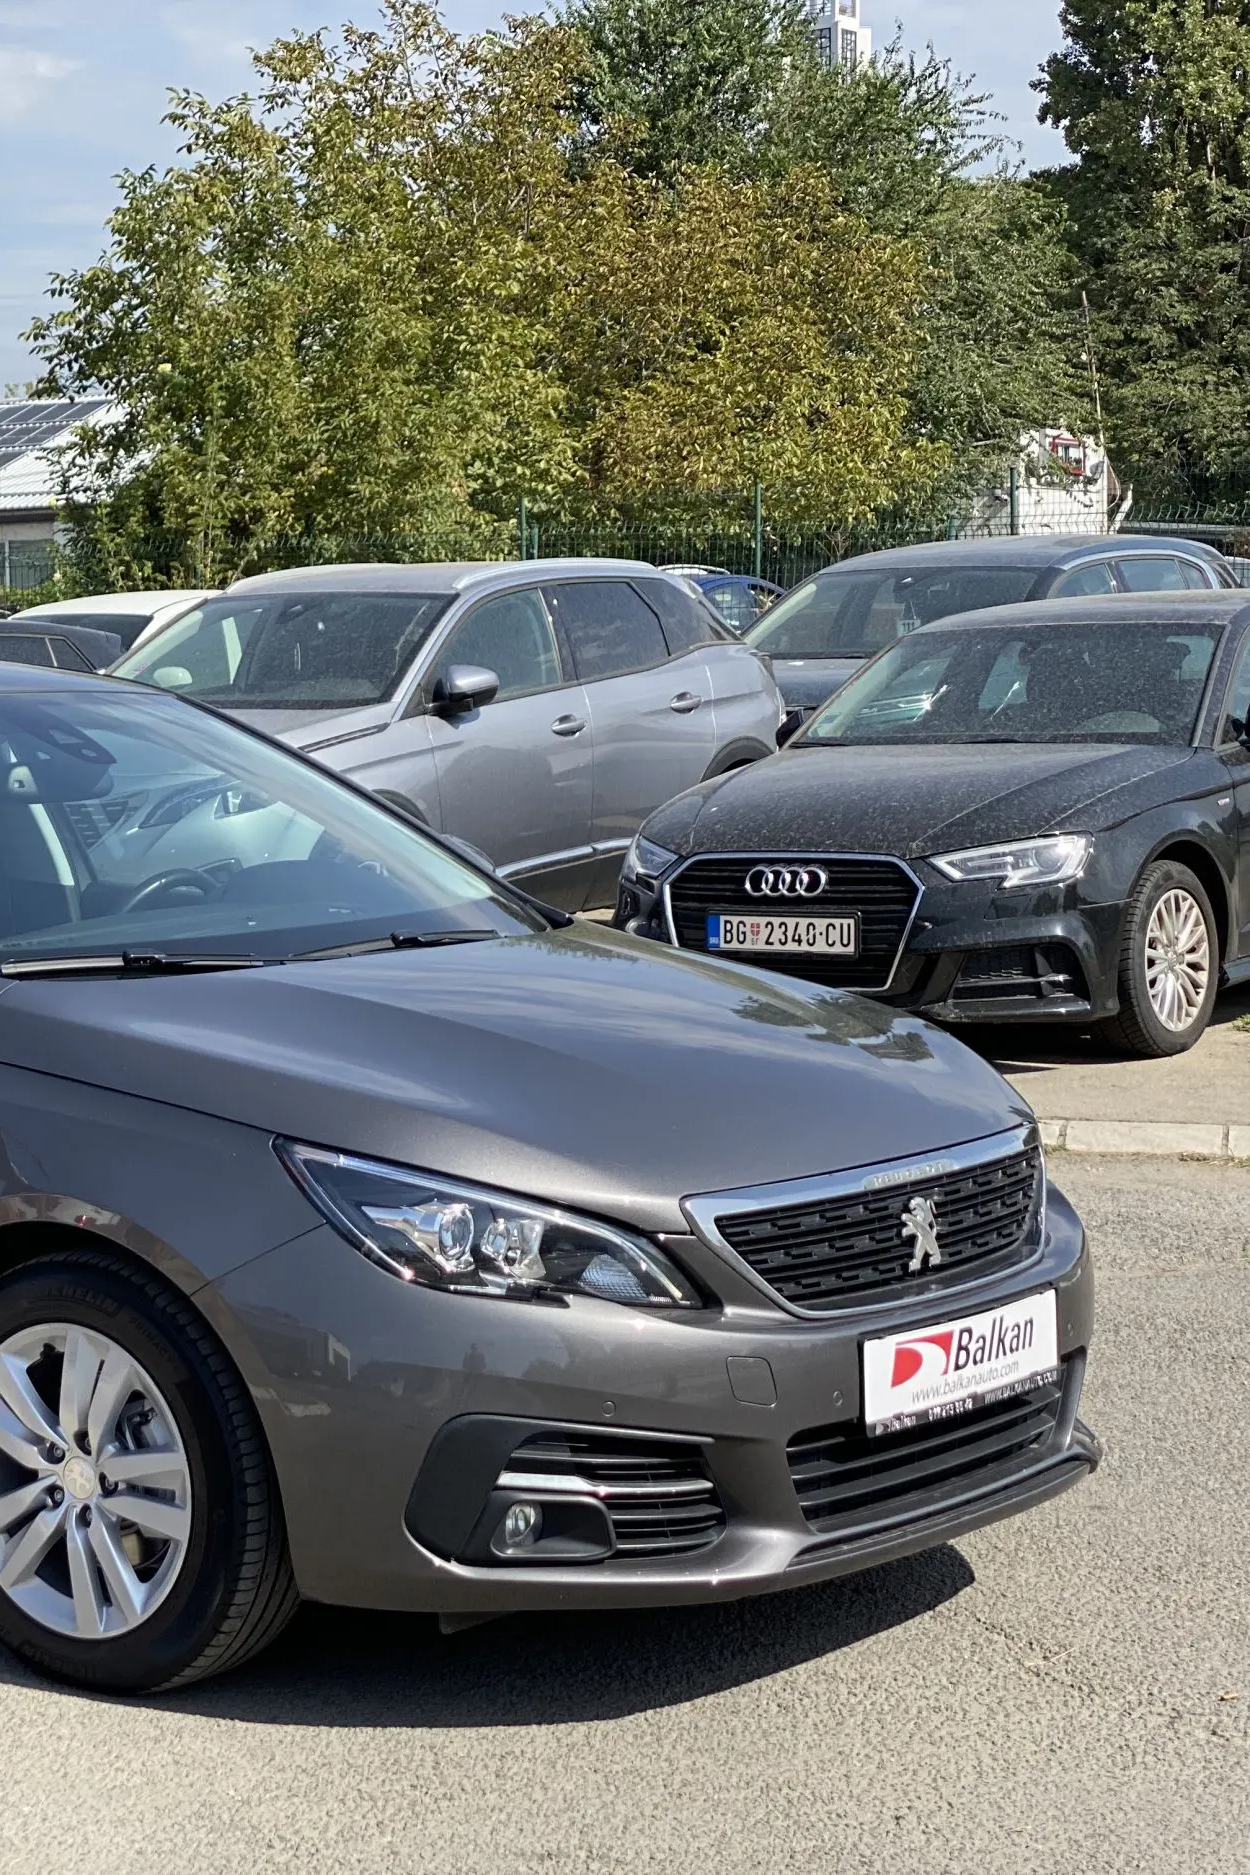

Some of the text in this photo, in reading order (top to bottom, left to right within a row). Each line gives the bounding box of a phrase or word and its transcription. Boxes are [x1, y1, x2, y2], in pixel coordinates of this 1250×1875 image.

[723, 920, 747, 945] BG
[953, 1315, 1034, 1372] Balkan
[910, 1359, 1019, 1405] www.balkanauto.com
